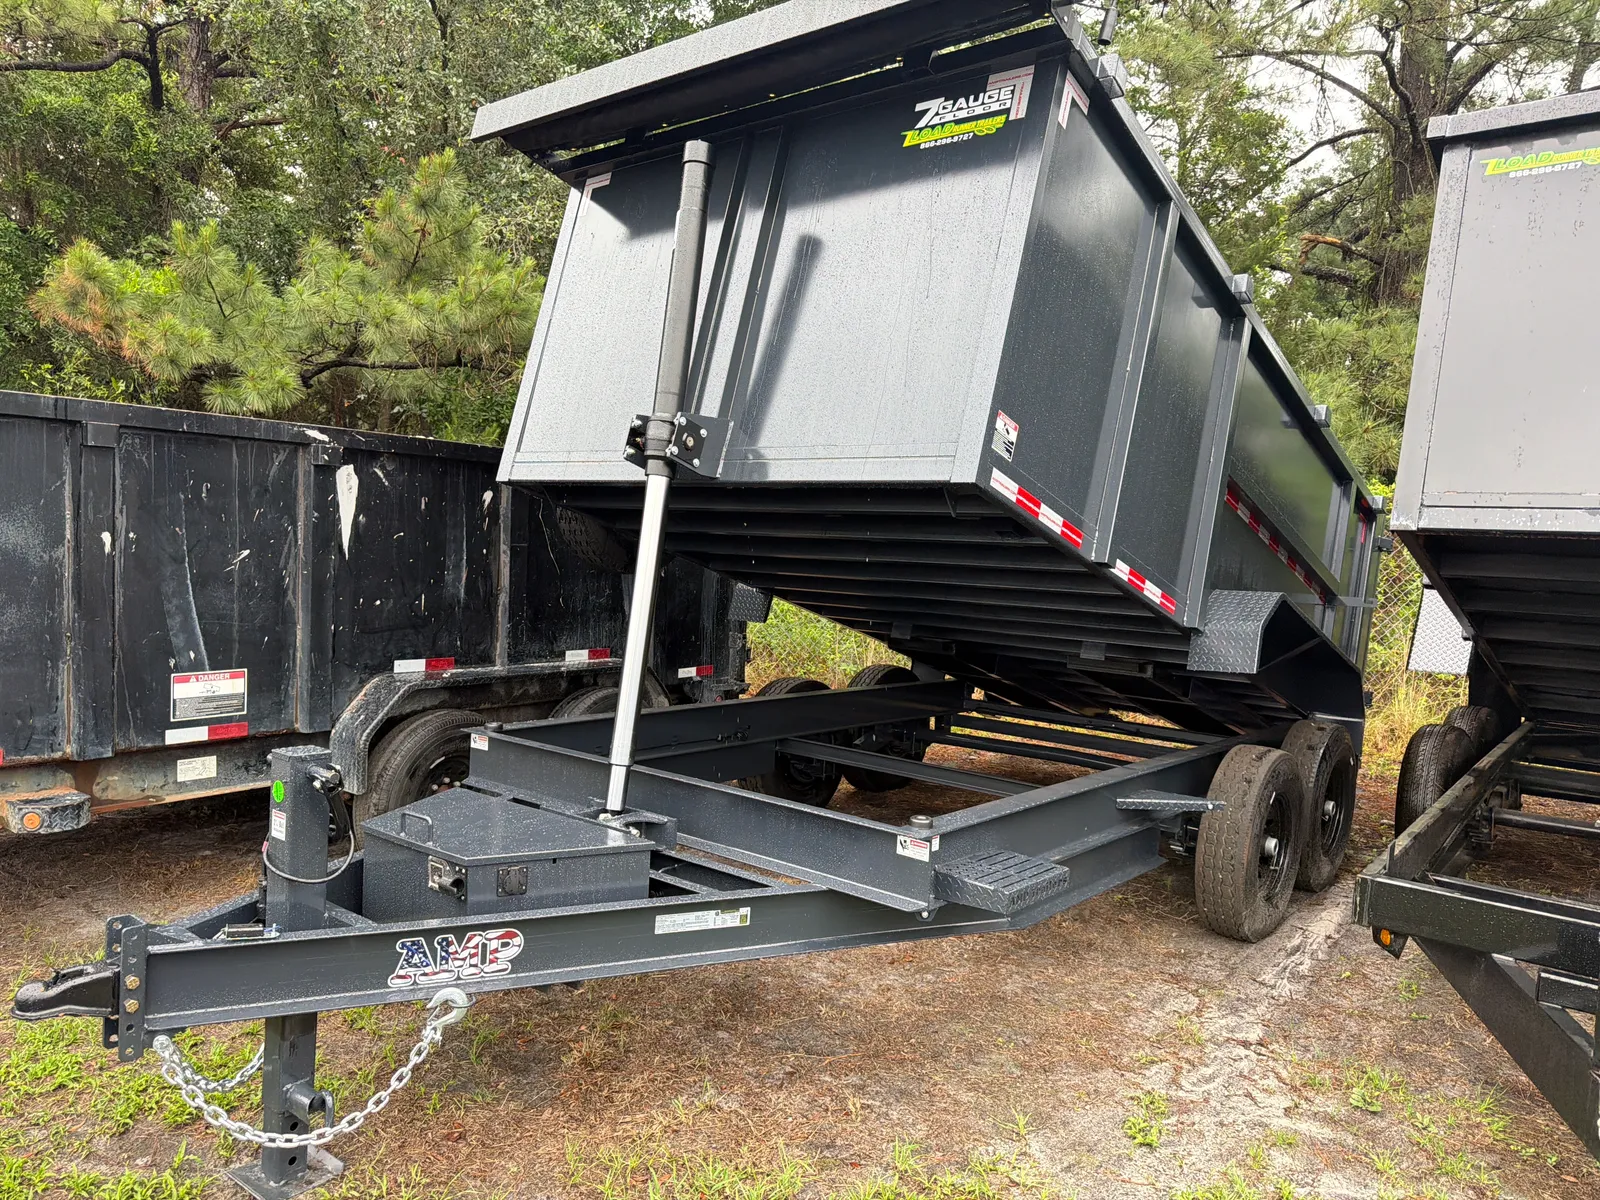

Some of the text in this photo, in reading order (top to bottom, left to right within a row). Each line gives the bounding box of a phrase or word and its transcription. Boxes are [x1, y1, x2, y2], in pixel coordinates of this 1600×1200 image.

[914, 86, 1015, 129] 7 GAUGE
[939, 102, 1007, 121] FLOOR
[911, 122, 955, 140] LOAD
[975, 115, 1007, 127] TRAILERS
[1495, 151, 1554, 169] LOAD
[198, 673, 230, 682] DANGER
[388, 928, 524, 987] AMP
